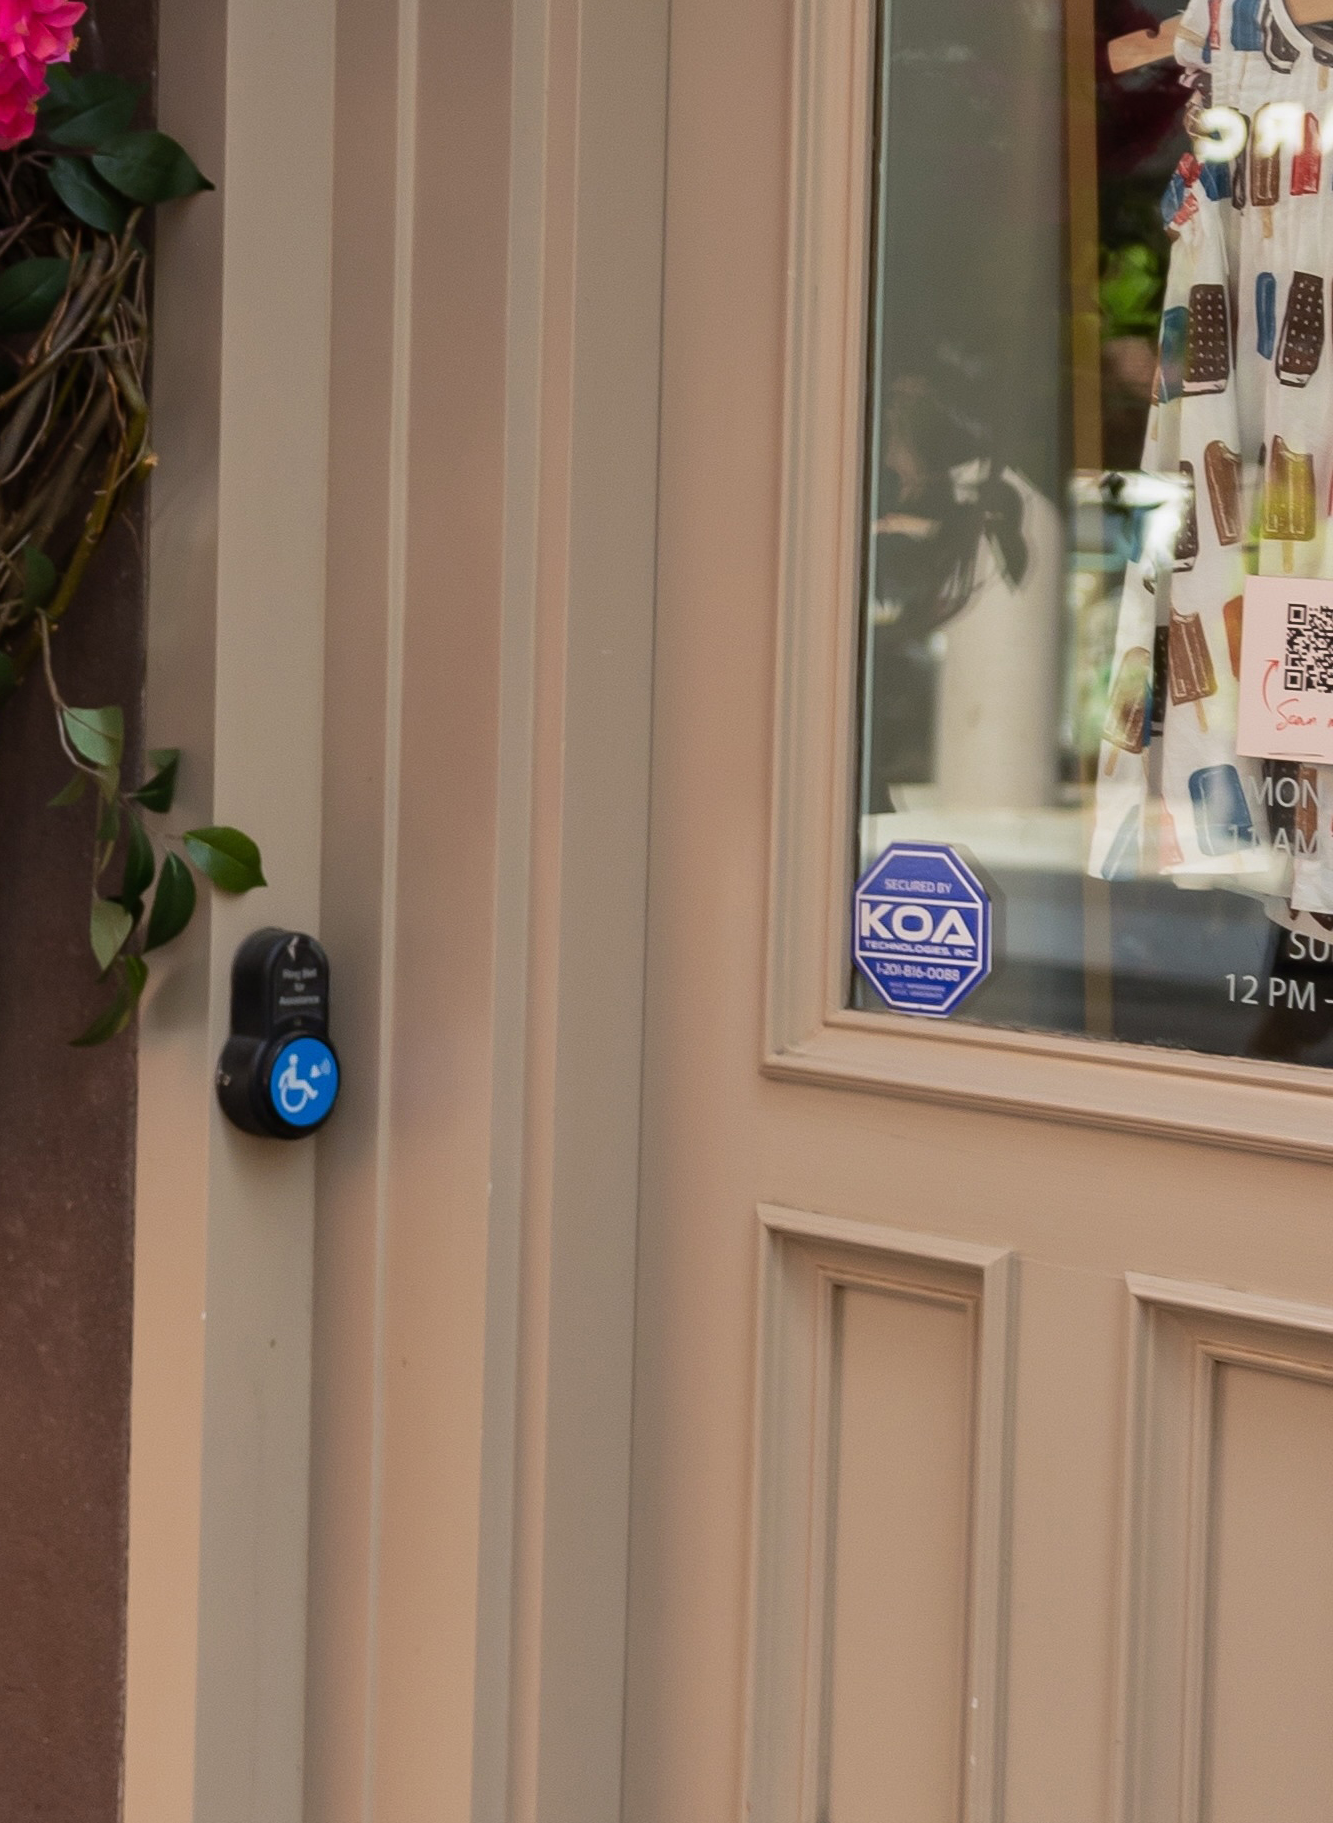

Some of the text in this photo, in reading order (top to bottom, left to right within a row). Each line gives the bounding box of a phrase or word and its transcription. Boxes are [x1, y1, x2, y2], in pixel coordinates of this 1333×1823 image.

[1247, 775, 1321, 809] MON
[1272, 827, 1319, 860] AM
[884, 878, 952, 894] SECURED BY
[861, 902, 976, 946] KOA
[1289, 930, 1333, 963] SU
[1225, 973, 1316, 1013] 12 PM
